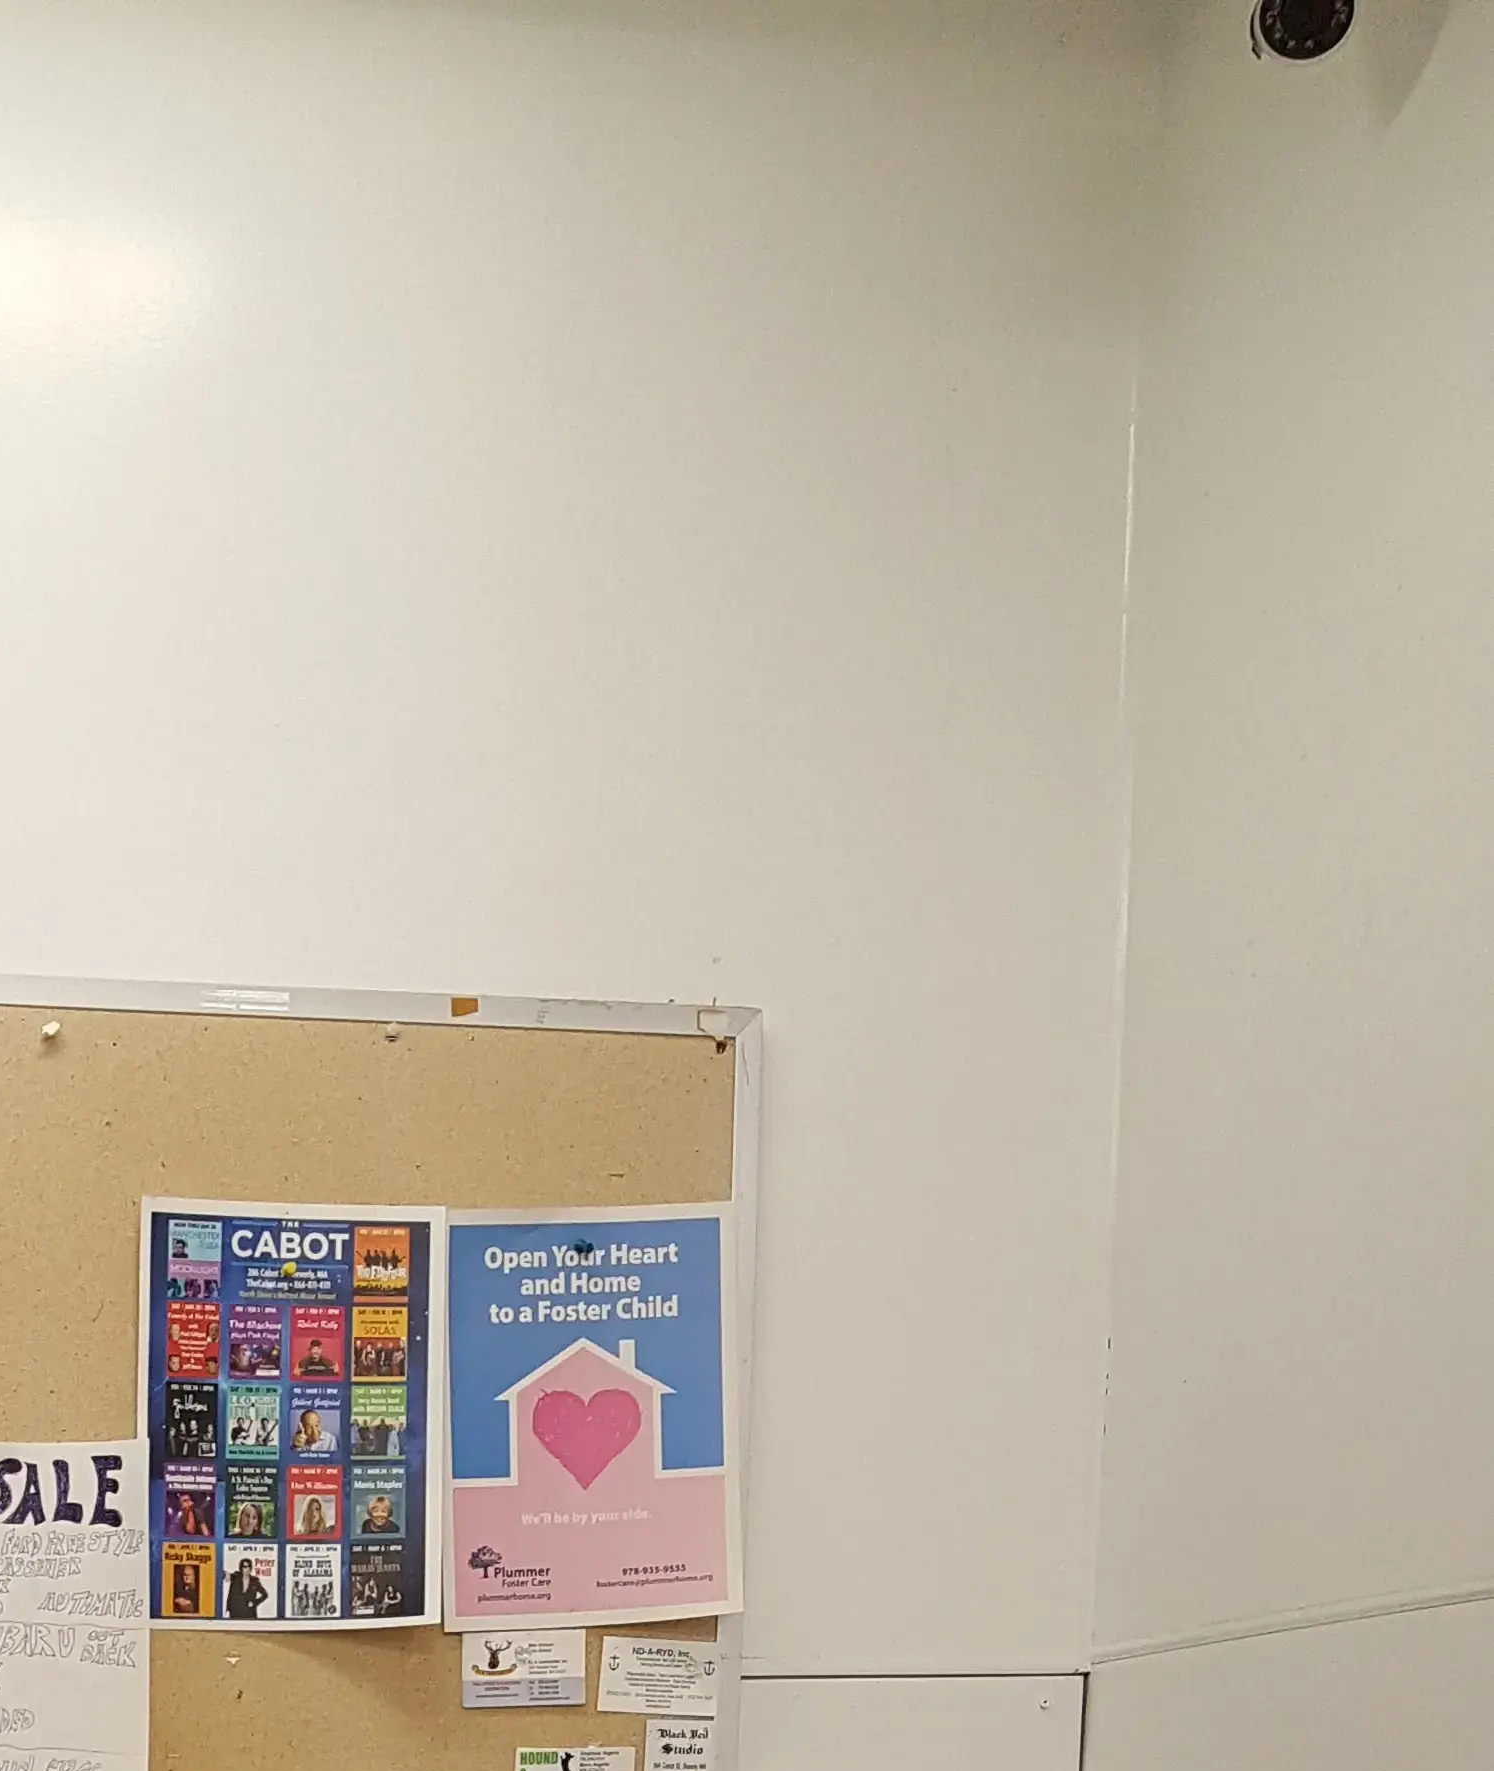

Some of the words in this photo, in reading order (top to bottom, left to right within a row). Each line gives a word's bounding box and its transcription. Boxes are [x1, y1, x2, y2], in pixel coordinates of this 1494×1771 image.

[231, 1229, 349, 1260] CABOT
[483, 1245, 548, 1270] Open
[551, 1244, 606, 1268] Your
[609, 1242, 679, 1266] Heart
[519, 1273, 566, 1296] and
[570, 1273, 642, 1294] Home
[488, 1303, 515, 1324] to
[518, 1305, 533, 1323] a
[537, 1299, 612, 1323] Foster
[615, 1295, 678, 1320] Child
[165, 1552, 183, 1561] Ricky
[186, 1553, 211, 1563] Skaggs
[493, 1565, 551, 1579] Plummer
[501, 1578, 530, 1588] Foster
[530, 1577, 552, 1587] Care
[657, 1728, 686, 1739] Black
[661, 1744, 703, 1755] Studio
[520, 1752, 558, 1765] HOUND
